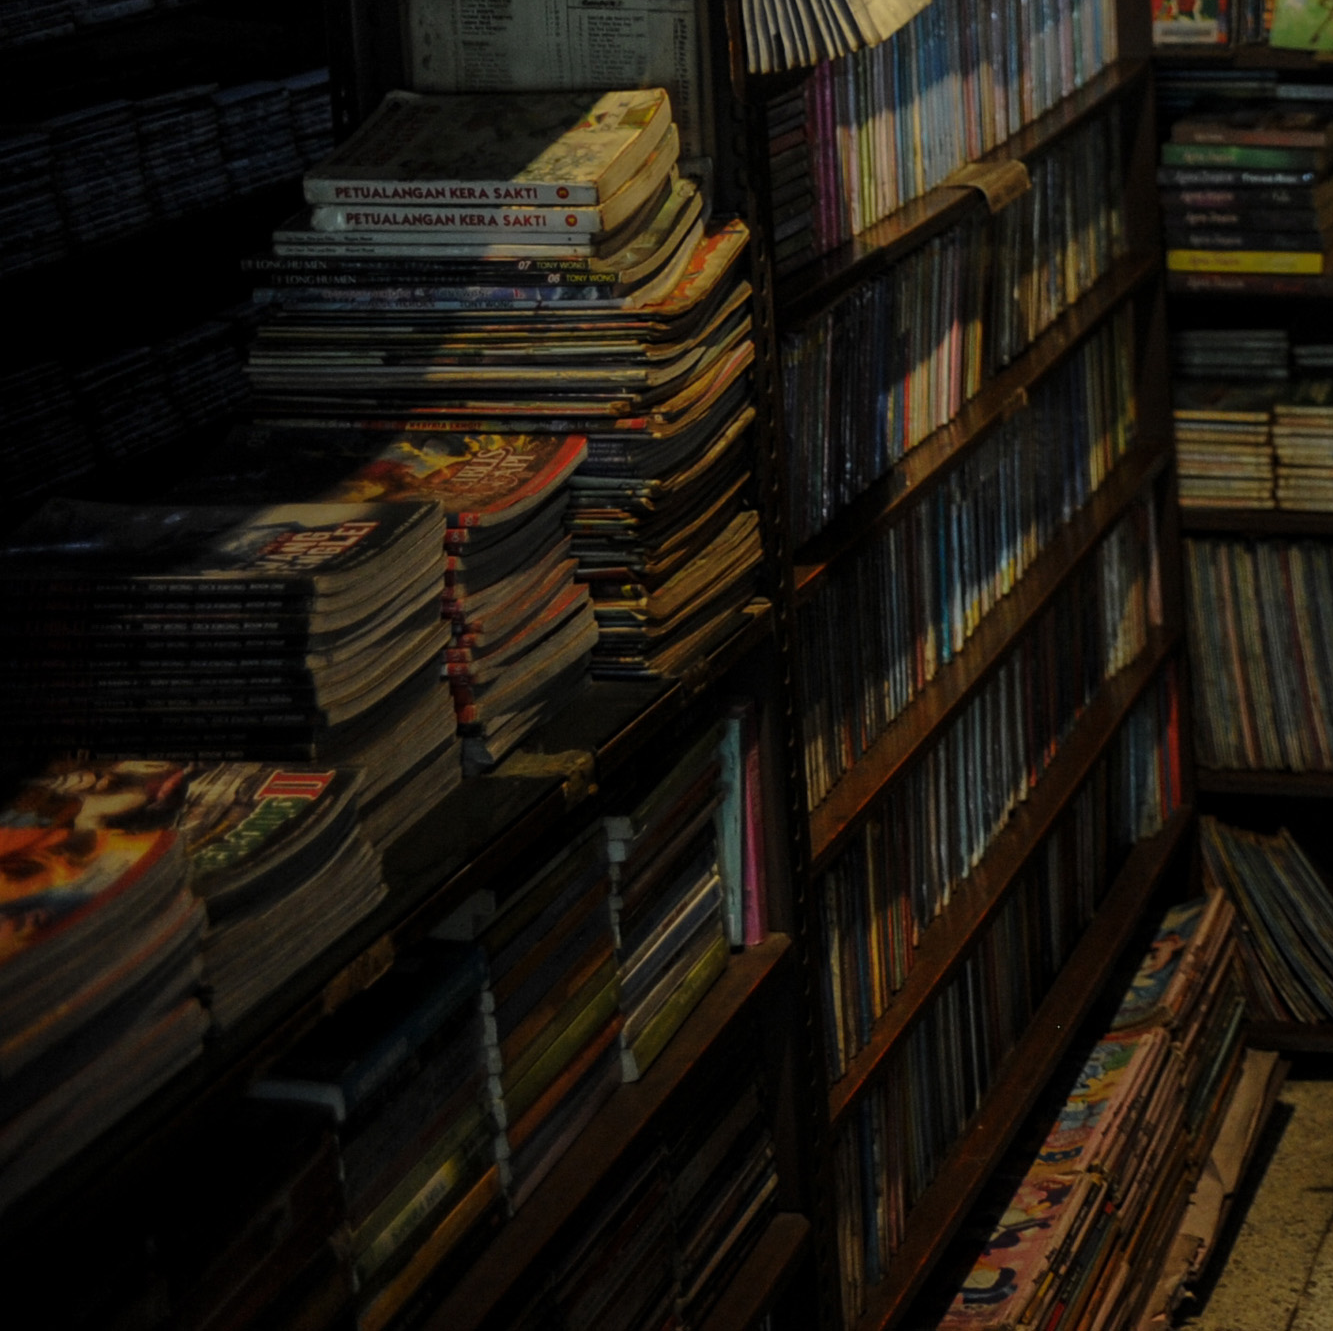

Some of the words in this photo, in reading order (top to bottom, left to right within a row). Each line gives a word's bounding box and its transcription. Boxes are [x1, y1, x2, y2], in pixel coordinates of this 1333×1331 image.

[335, 186, 446, 200] PETUALANGAN
[450, 186, 488, 199] KERA
[494, 186, 538, 200] SAKTI
[346, 212, 455, 227] PETUALANGAN
[459, 212, 498, 227] KERA
[503, 212, 547, 227] SAKTI
[518, 260, 531, 270] 07
[536, 261, 560, 269] TONY
[561, 261, 588, 269] WONG
[547, 273, 561, 284] 06
[566, 274, 588, 283] TONY
[589, 274, 616, 283] WONG
